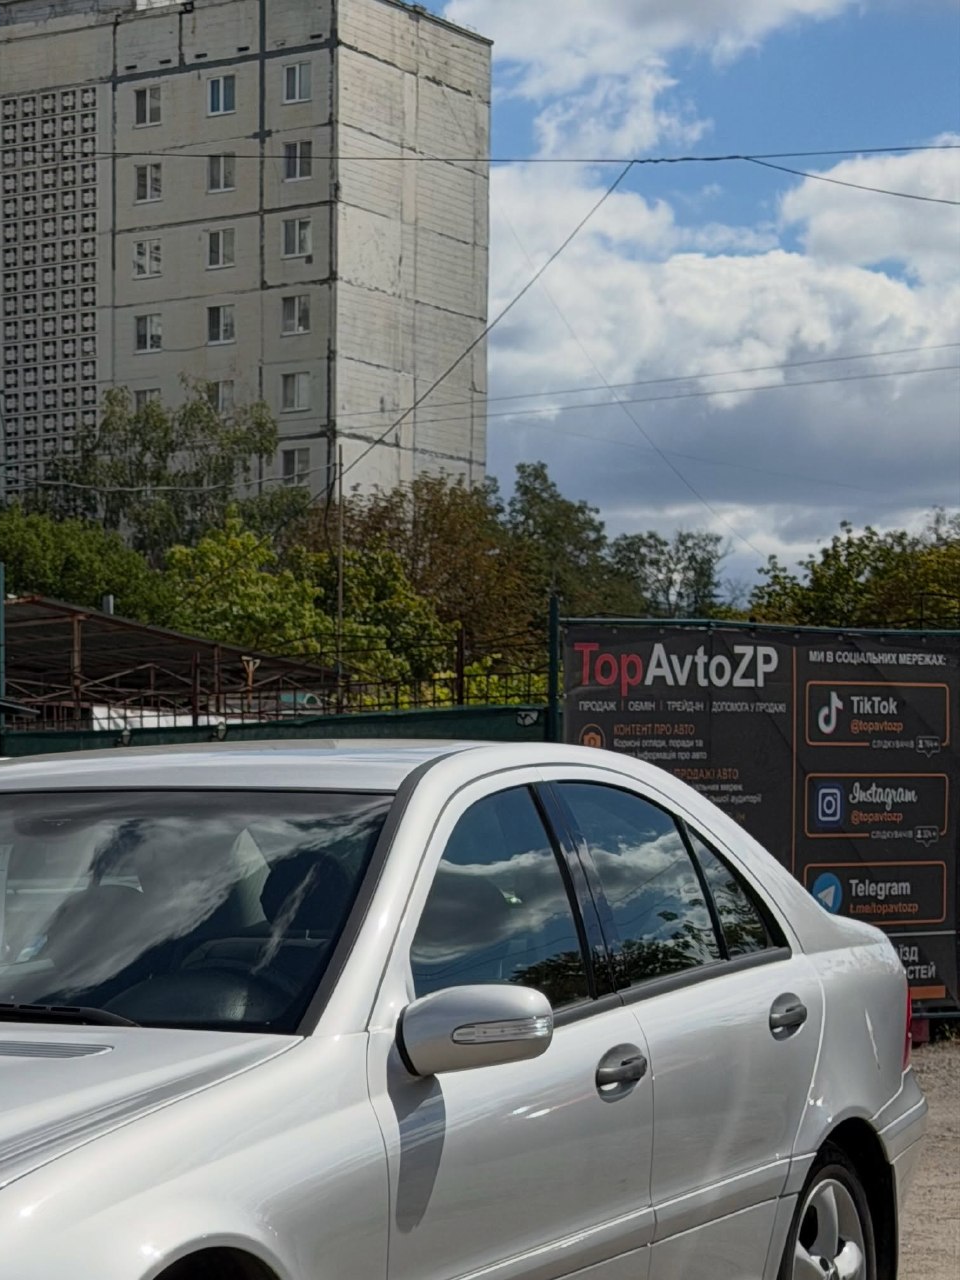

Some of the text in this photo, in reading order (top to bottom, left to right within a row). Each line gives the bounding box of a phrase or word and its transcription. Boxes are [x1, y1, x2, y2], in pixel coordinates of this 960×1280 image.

[809, 651, 946, 666] МИ В СОЦІАЛЬНИХ МЕРЕЖАХ:
[579, 701, 617, 713] ПРОДАЖ
[628, 701, 656, 713] ОБМІН
[850, 696, 898, 715] TikTok
[613, 723, 696, 736] КОНТЕНТ ПРО АВТО
[850, 719, 904, 734] @topavtozp
[717, 768, 740, 780] АВТО
[849, 782, 917, 810] Instagram
[851, 810, 903, 825] @topavtozp
[849, 879, 911, 900] Telegram
[849, 902, 918, 915] t.me/topavtozp
[896, 944, 919, 962] ЇЗД
